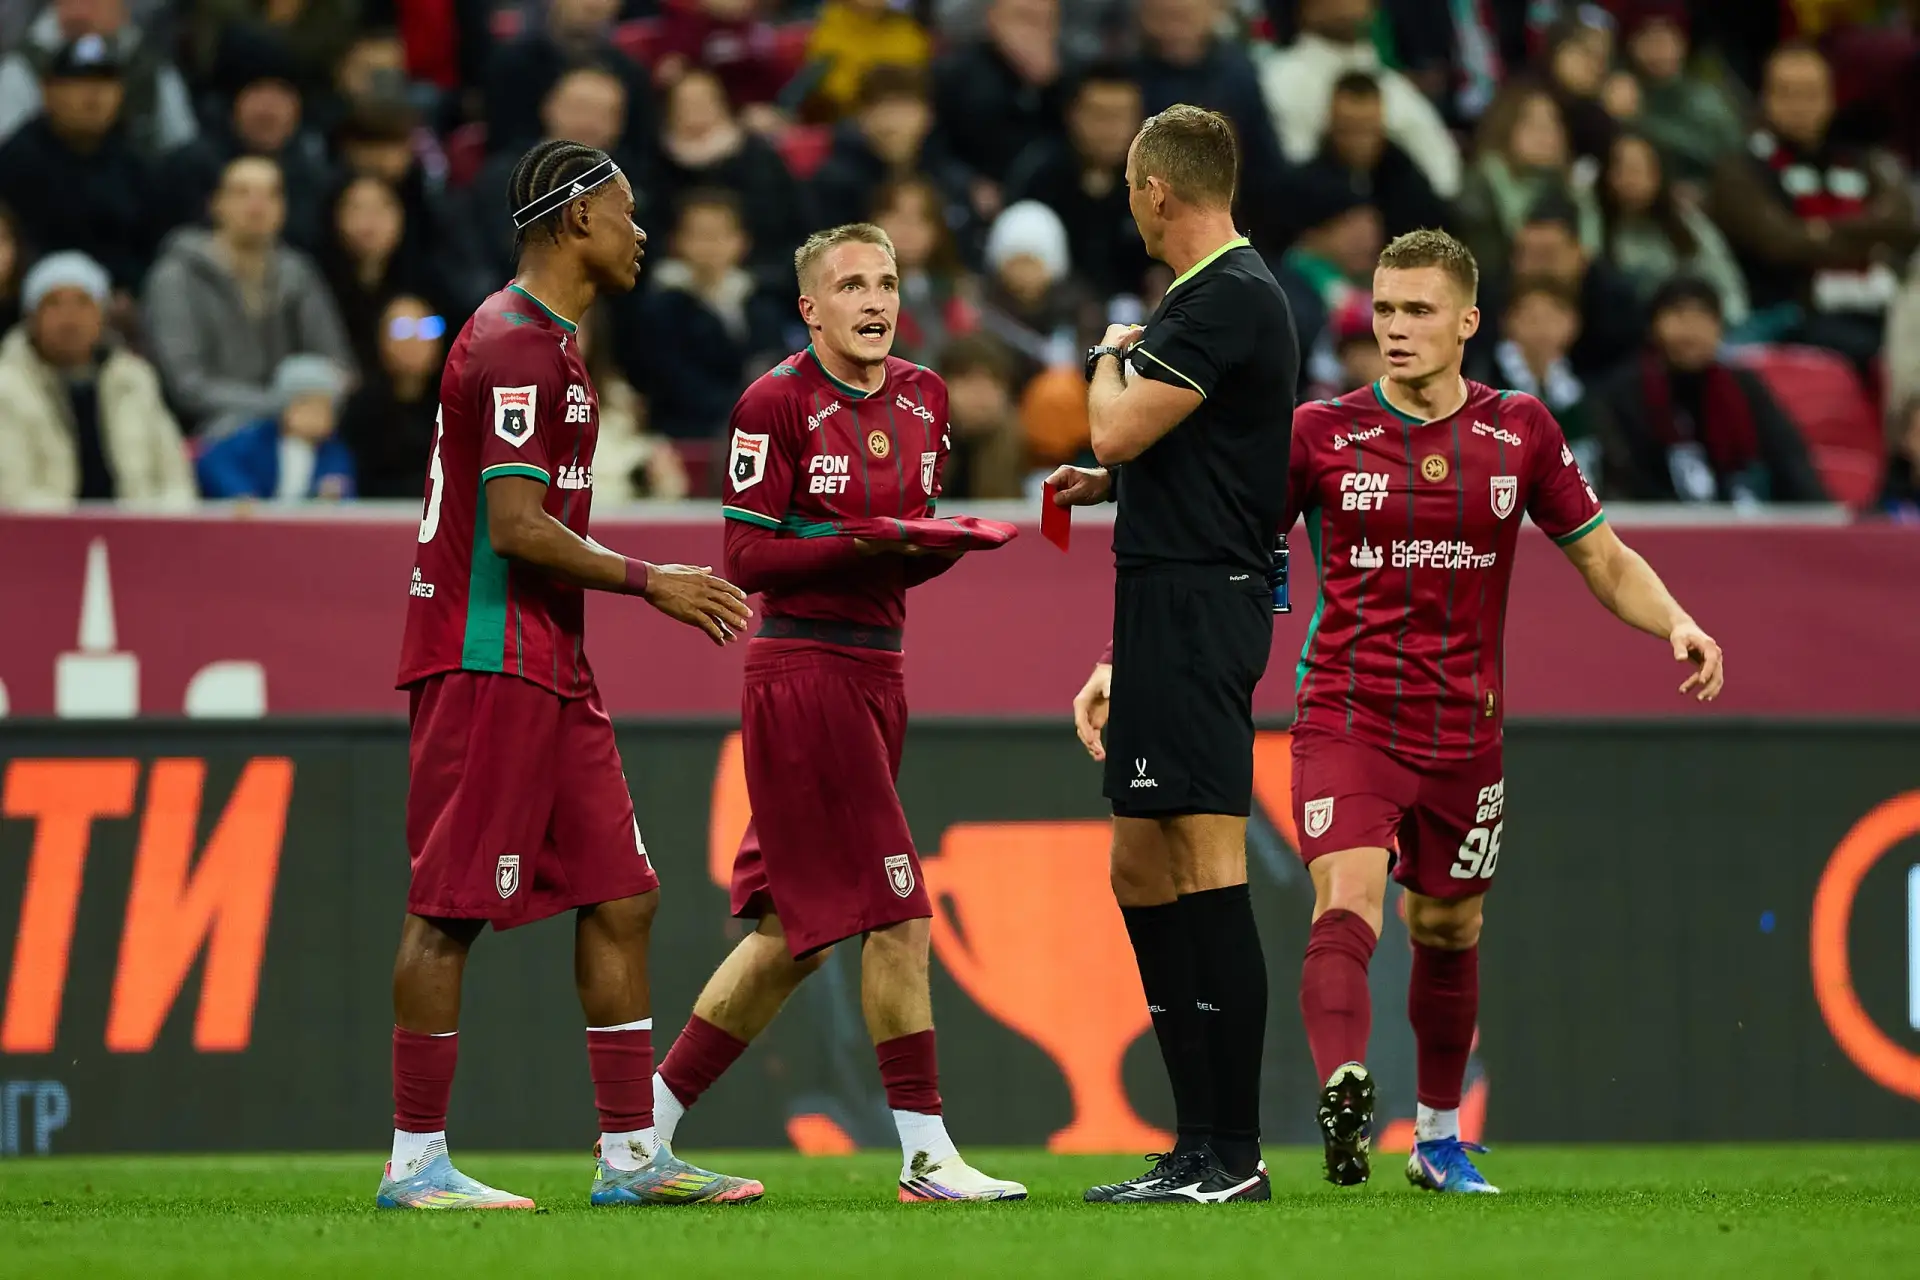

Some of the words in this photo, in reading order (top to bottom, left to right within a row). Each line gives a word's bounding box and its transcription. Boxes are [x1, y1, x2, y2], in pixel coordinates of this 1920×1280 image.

[565, 405, 591, 423] BET
[808, 455, 849, 474] FON
[808, 476, 851, 494] BET
[1340, 472, 1390, 492] FON
[1341, 491, 1389, 511] BET
[1391, 540, 1474, 555] КАЗАНЬ
[1391, 552, 1497, 570] ОРГСИНТЕЗ
[1449, 820, 1504, 880] 98
